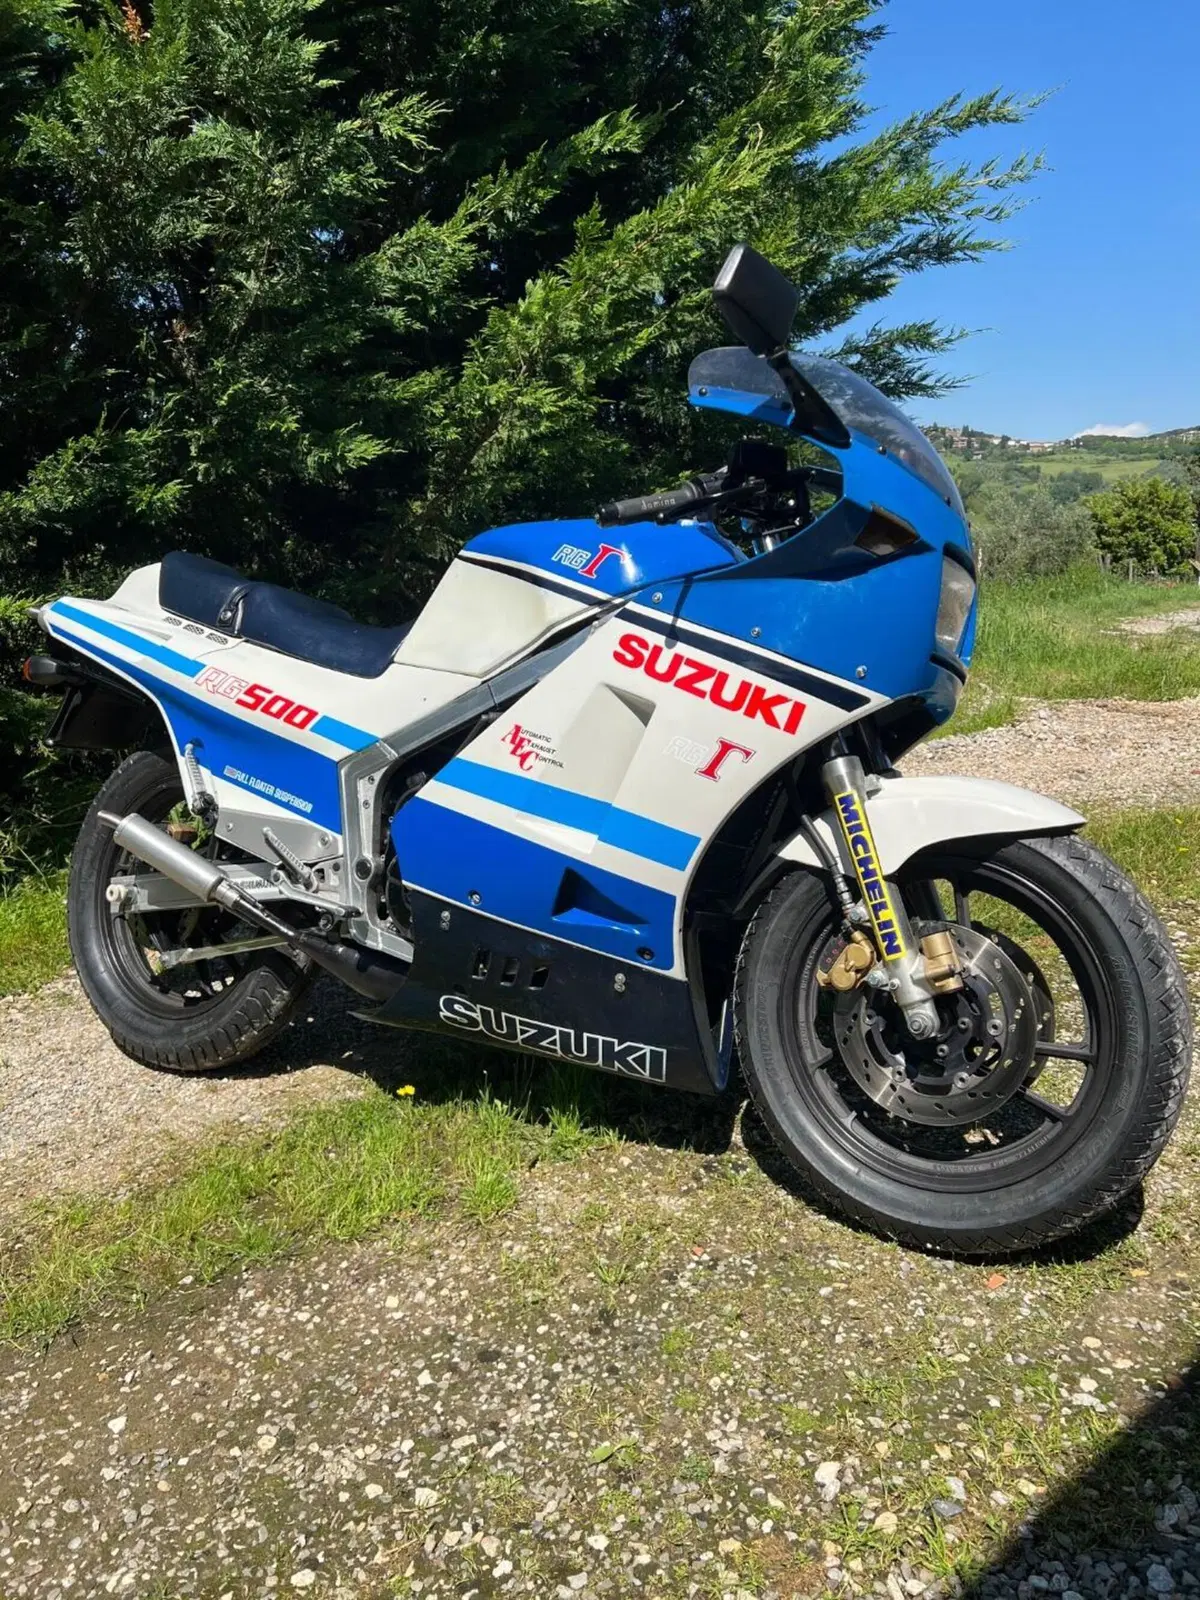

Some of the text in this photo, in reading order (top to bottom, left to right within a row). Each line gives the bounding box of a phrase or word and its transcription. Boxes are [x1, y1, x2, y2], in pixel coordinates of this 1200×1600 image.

[195, 666, 319, 730] RG500
[613, 633, 806, 735] SUZUKI
[838, 793, 902, 956] MICHELIN
[440, 994, 667, 1082] SUZUKI
